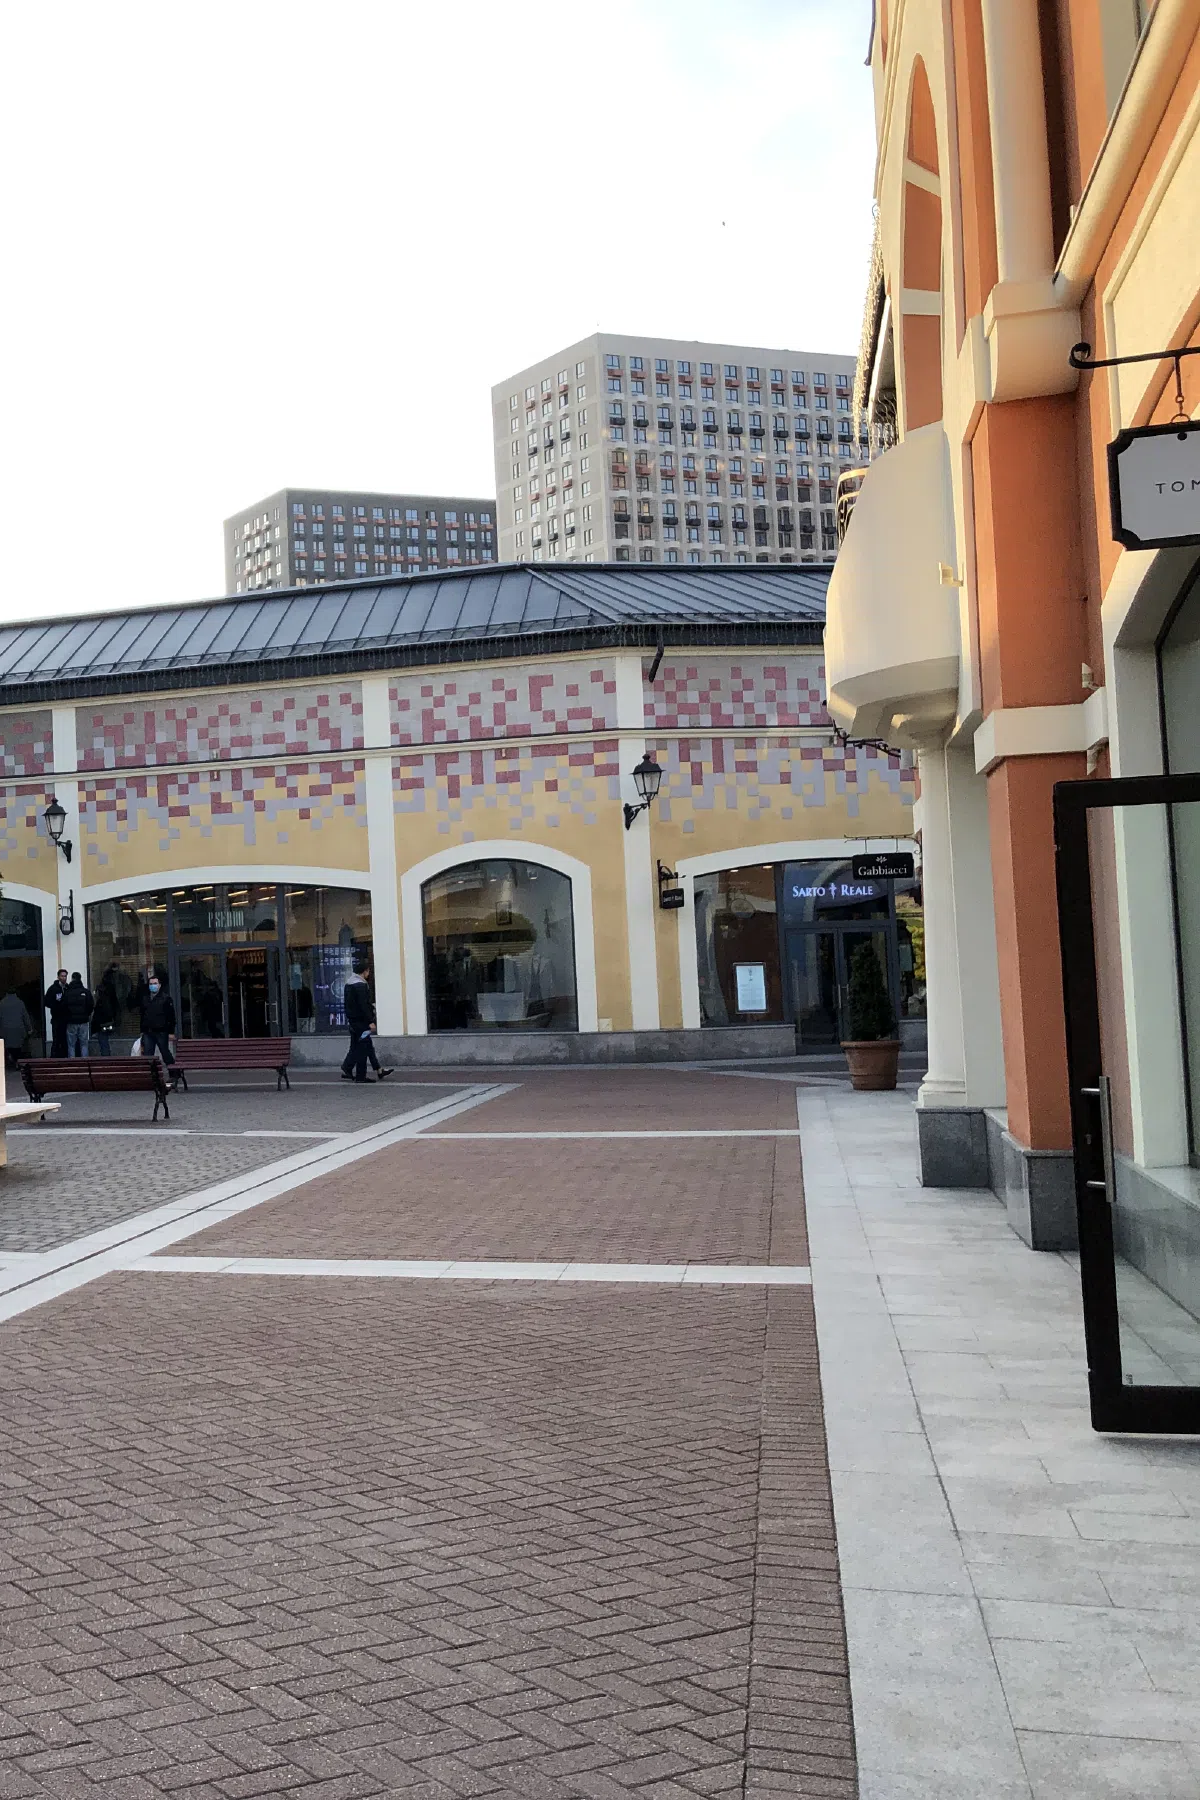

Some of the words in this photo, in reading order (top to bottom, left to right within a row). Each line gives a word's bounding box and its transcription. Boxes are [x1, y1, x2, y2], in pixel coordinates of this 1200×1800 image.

[858, 864, 907, 876] Gabbiacci
[792, 886, 826, 897] SARTO
[841, 884, 874, 896] REALE
